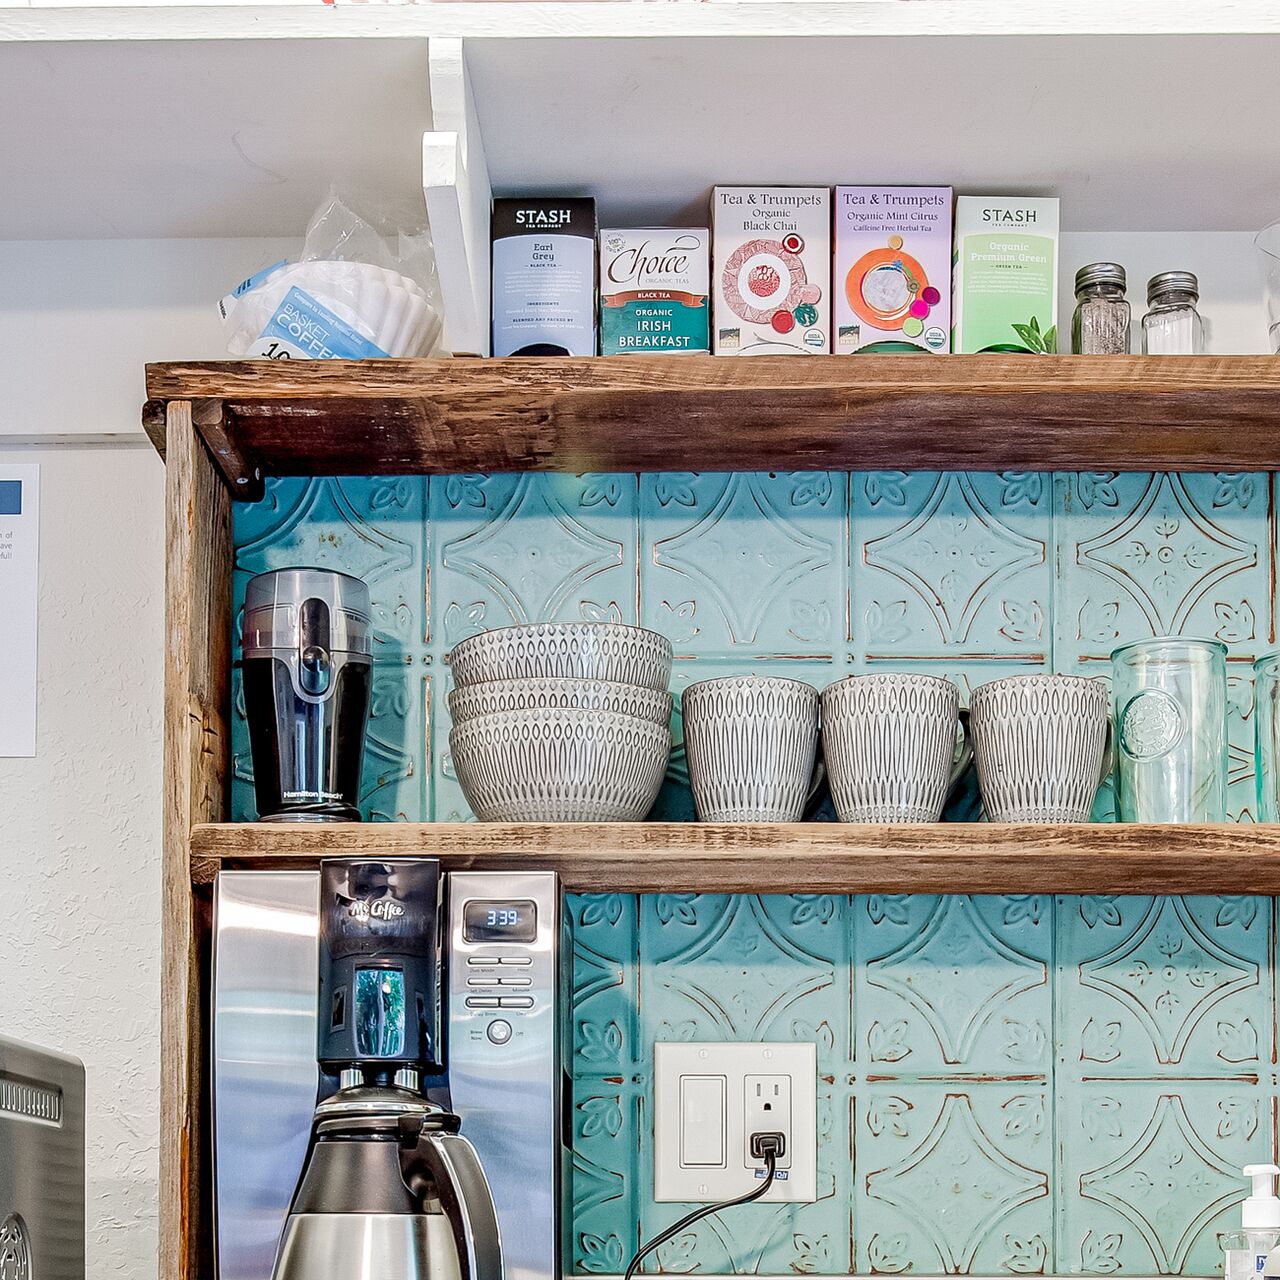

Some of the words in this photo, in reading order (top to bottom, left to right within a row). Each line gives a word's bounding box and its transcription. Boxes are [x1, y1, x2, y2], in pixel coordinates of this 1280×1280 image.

[721, 194, 743, 204] Tea
[747, 194, 757, 204] &
[761, 194, 821, 207] Trumpets
[843, 194, 865, 204] Tea
[870, 194, 880, 204] &
[883, 194, 944, 207] Trumpets
[516, 210, 571, 223] STASH
[752, 209, 791, 219] Organic
[847, 211, 884, 221] Organic
[887, 212, 908, 220] Mint
[911, 212, 938, 220] Citrus
[983, 209, 1036, 222] STASH
[743, 221, 770, 230] Black
[774, 221, 797, 230] Chai
[989, 242, 1029, 251] Organic
[608, 240, 690, 287] Choice
[971, 253, 1015, 261] Premium
[1019, 254, 1047, 263] Green
[283, 303, 330, 342] BASKET
[637, 321, 671, 331] IRISH
[620, 337, 690, 346] BREAKFAST
[371, 901, 404, 920] Coffee
[487, 911, 517, 925] 3:39
